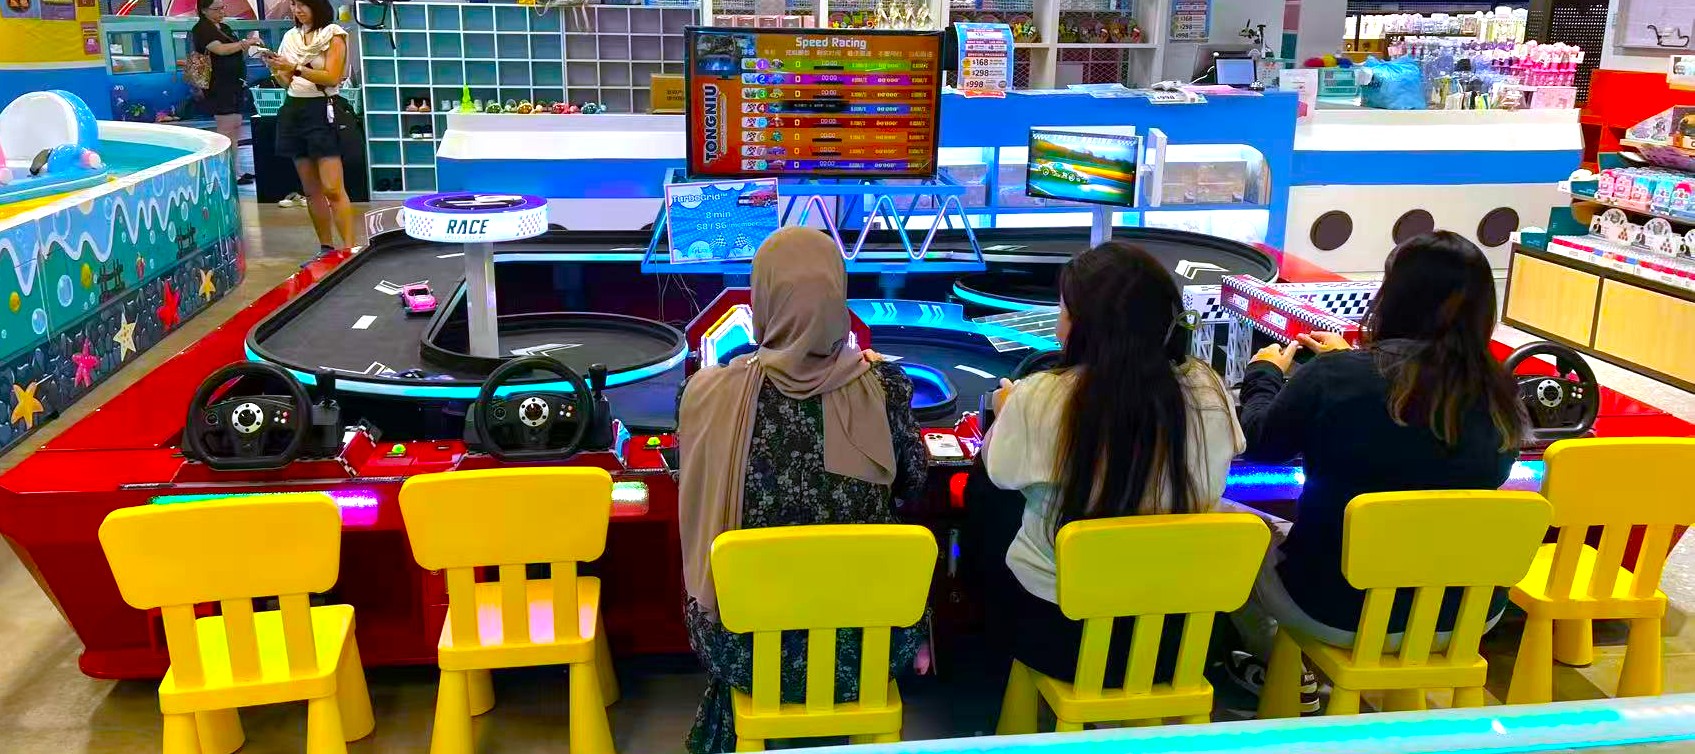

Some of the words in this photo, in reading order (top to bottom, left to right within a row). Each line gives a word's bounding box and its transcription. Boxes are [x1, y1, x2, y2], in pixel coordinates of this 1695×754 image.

[796, 38, 829, 48] Speed
[831, 38, 867, 49] Racing
[795, 75, 800, 83] 0
[705, 86, 717, 161] TONGNIU
[446, 219, 489, 234] RACE
